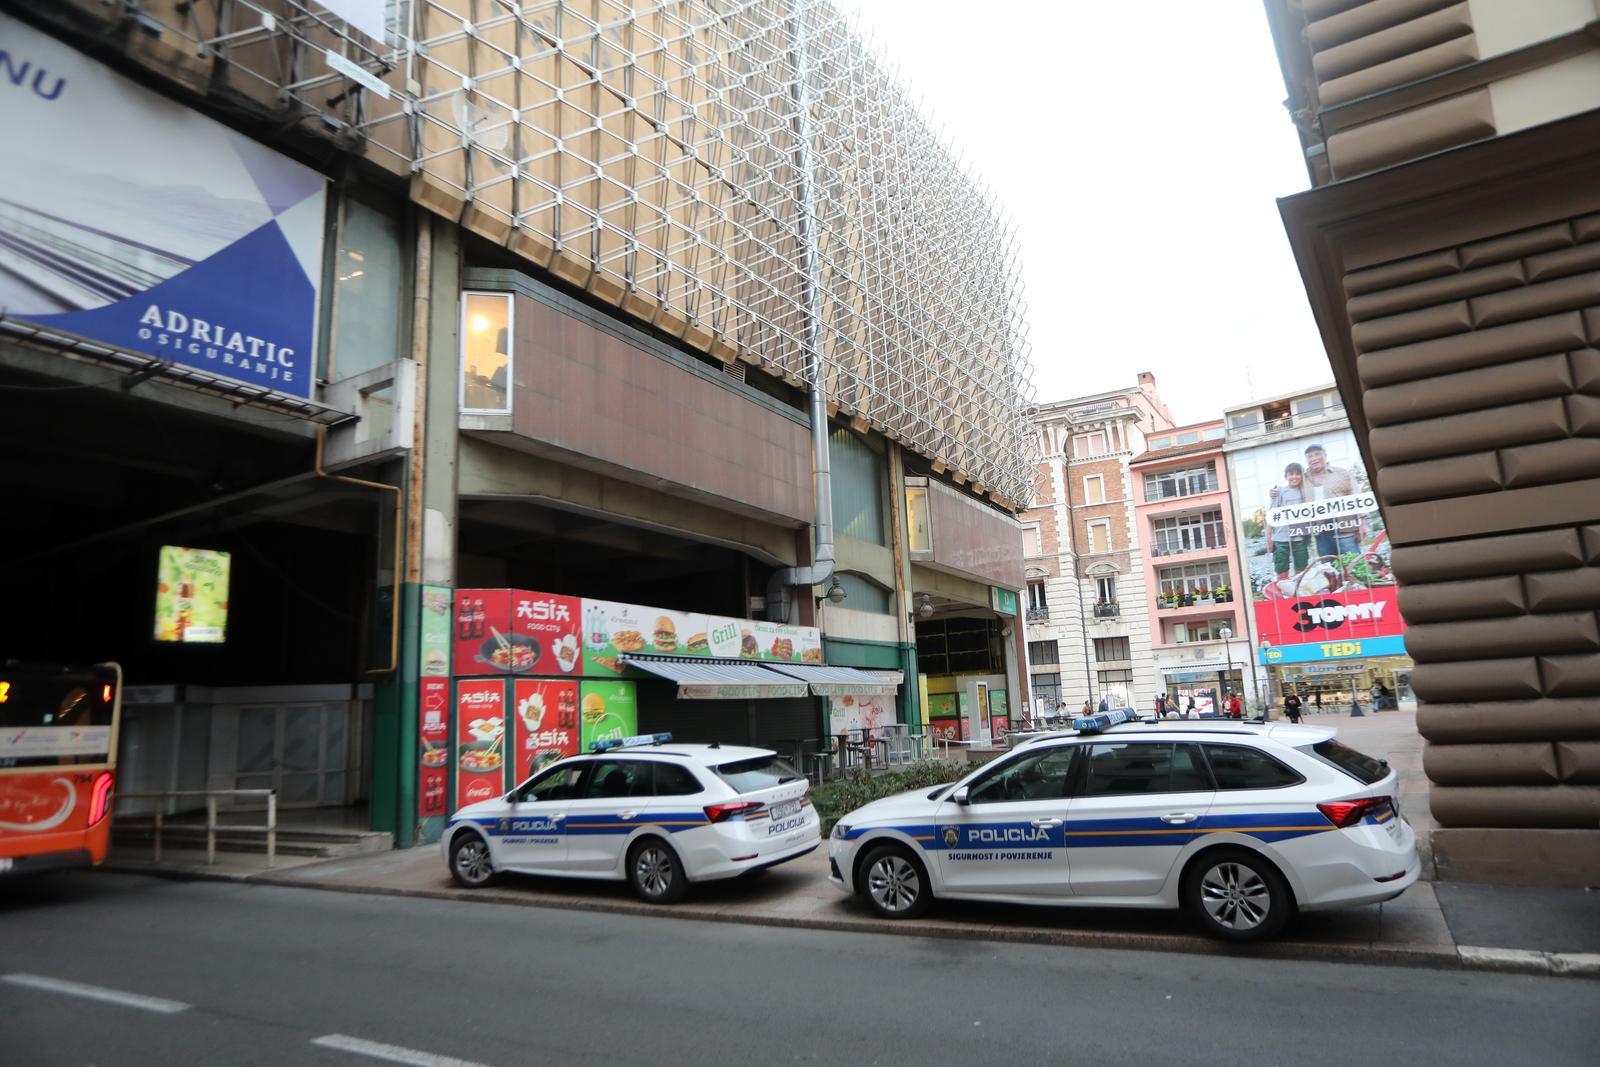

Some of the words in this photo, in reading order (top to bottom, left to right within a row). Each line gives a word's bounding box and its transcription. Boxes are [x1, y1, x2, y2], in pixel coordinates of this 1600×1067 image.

[139, 304, 295, 368] ADRIATIC
[138, 328, 293, 382] OSIGURANJE
[1272, 496, 1375, 522] #TvojeMisto
[1288, 527, 1304, 537] ZA
[1306, 518, 1362, 535] TRADICIJU
[1308, 601, 1387, 624] TOMMY
[712, 623, 737, 645] Grill
[1320, 642, 1362, 657] TEDi
[512, 820, 558, 832] POLICIJA
[769, 816, 805, 836] POLICIJA
[967, 828, 1051, 843] POLICIJA
[948, 852, 993, 861] SIGURNOST
[1000, 851, 1053, 860] POVJERENJE
